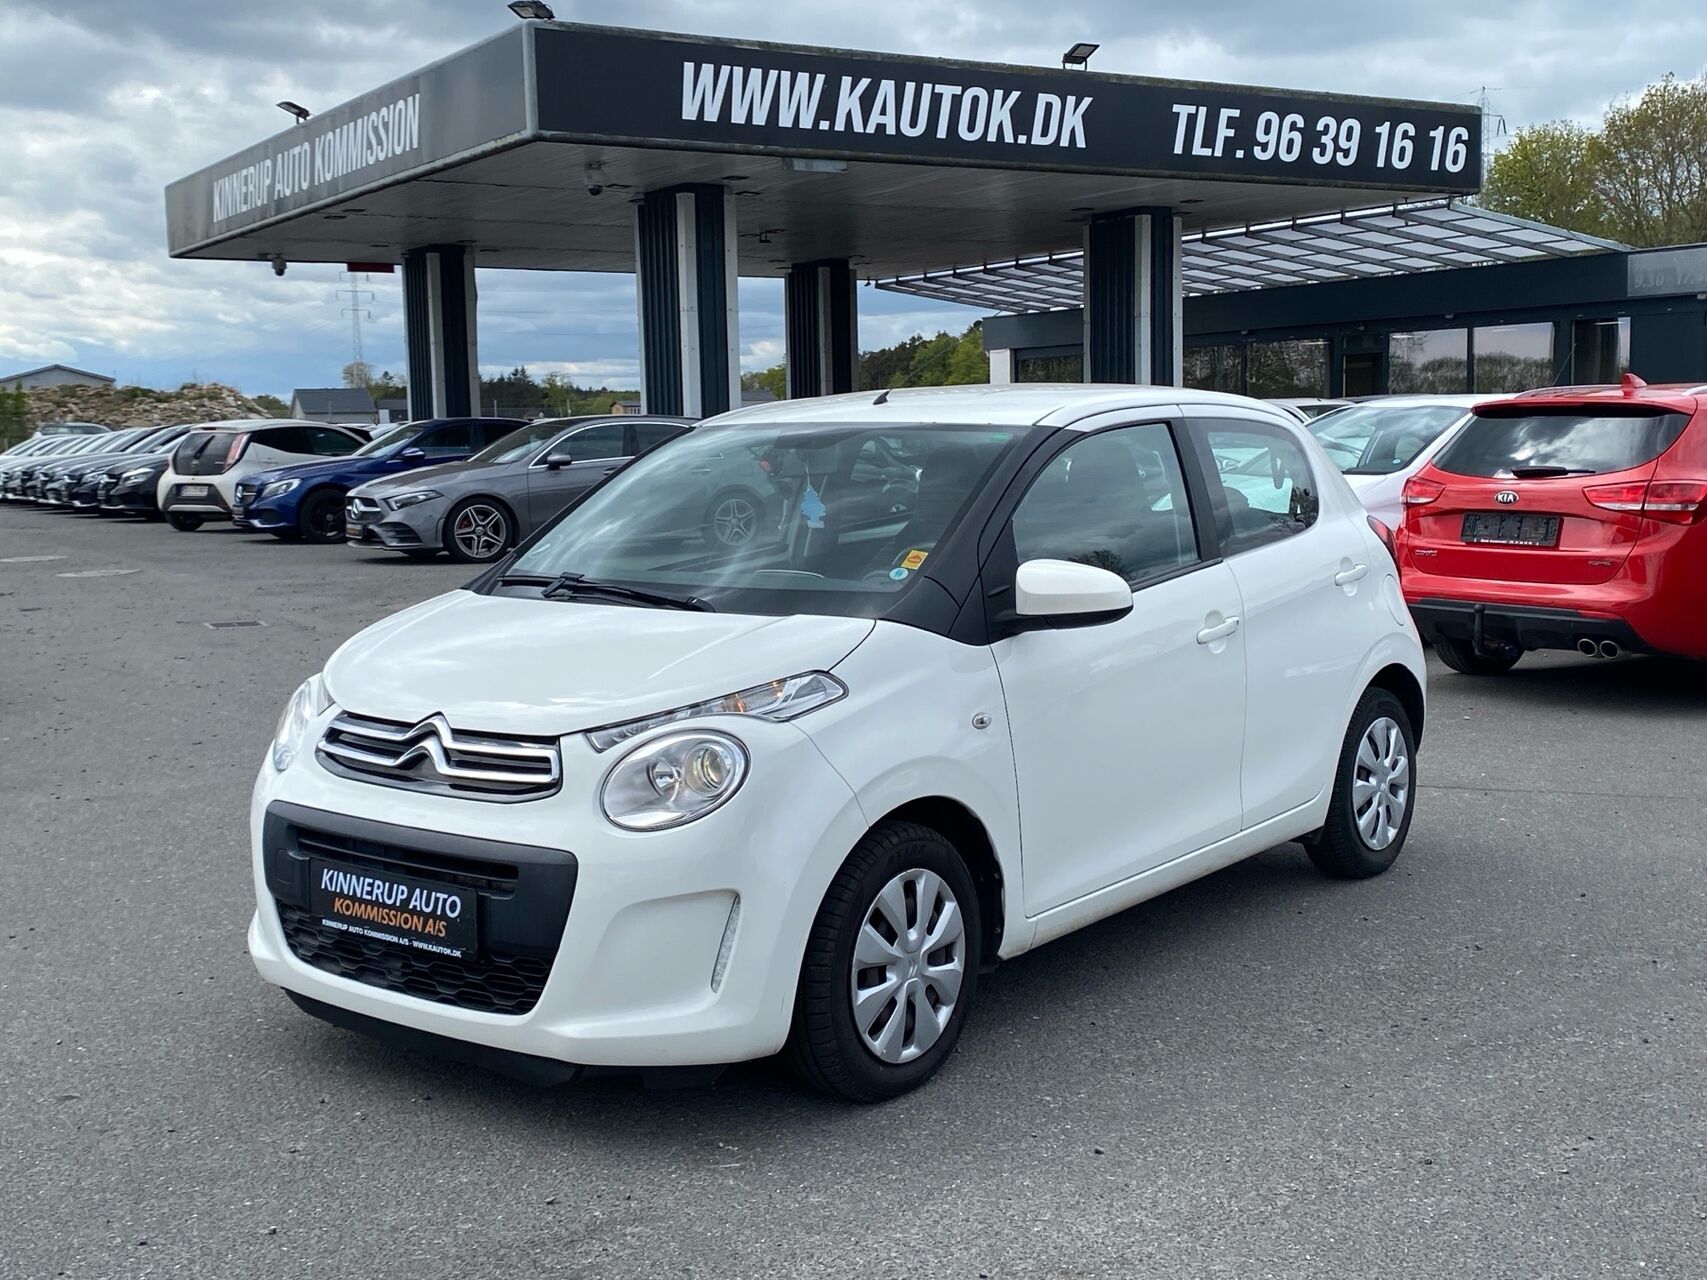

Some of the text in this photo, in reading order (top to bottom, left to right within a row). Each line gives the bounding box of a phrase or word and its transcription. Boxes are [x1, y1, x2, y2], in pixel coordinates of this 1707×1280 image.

[681, 61, 1094, 149] WWW.KAUTOK.DK
[213, 93, 420, 222] KINNERUP AUTO KOMMISSION
[1172, 103, 1469, 173] TLF. 96 39 16 16
[1497, 493, 1515, 503] KIA
[321, 868, 462, 918] KINNERUP AUTO
[334, 897, 447, 937] KOMMISSION A/S
[321, 919, 349, 931] KINNERUP
[348, 925, 364, 935] AUTO
